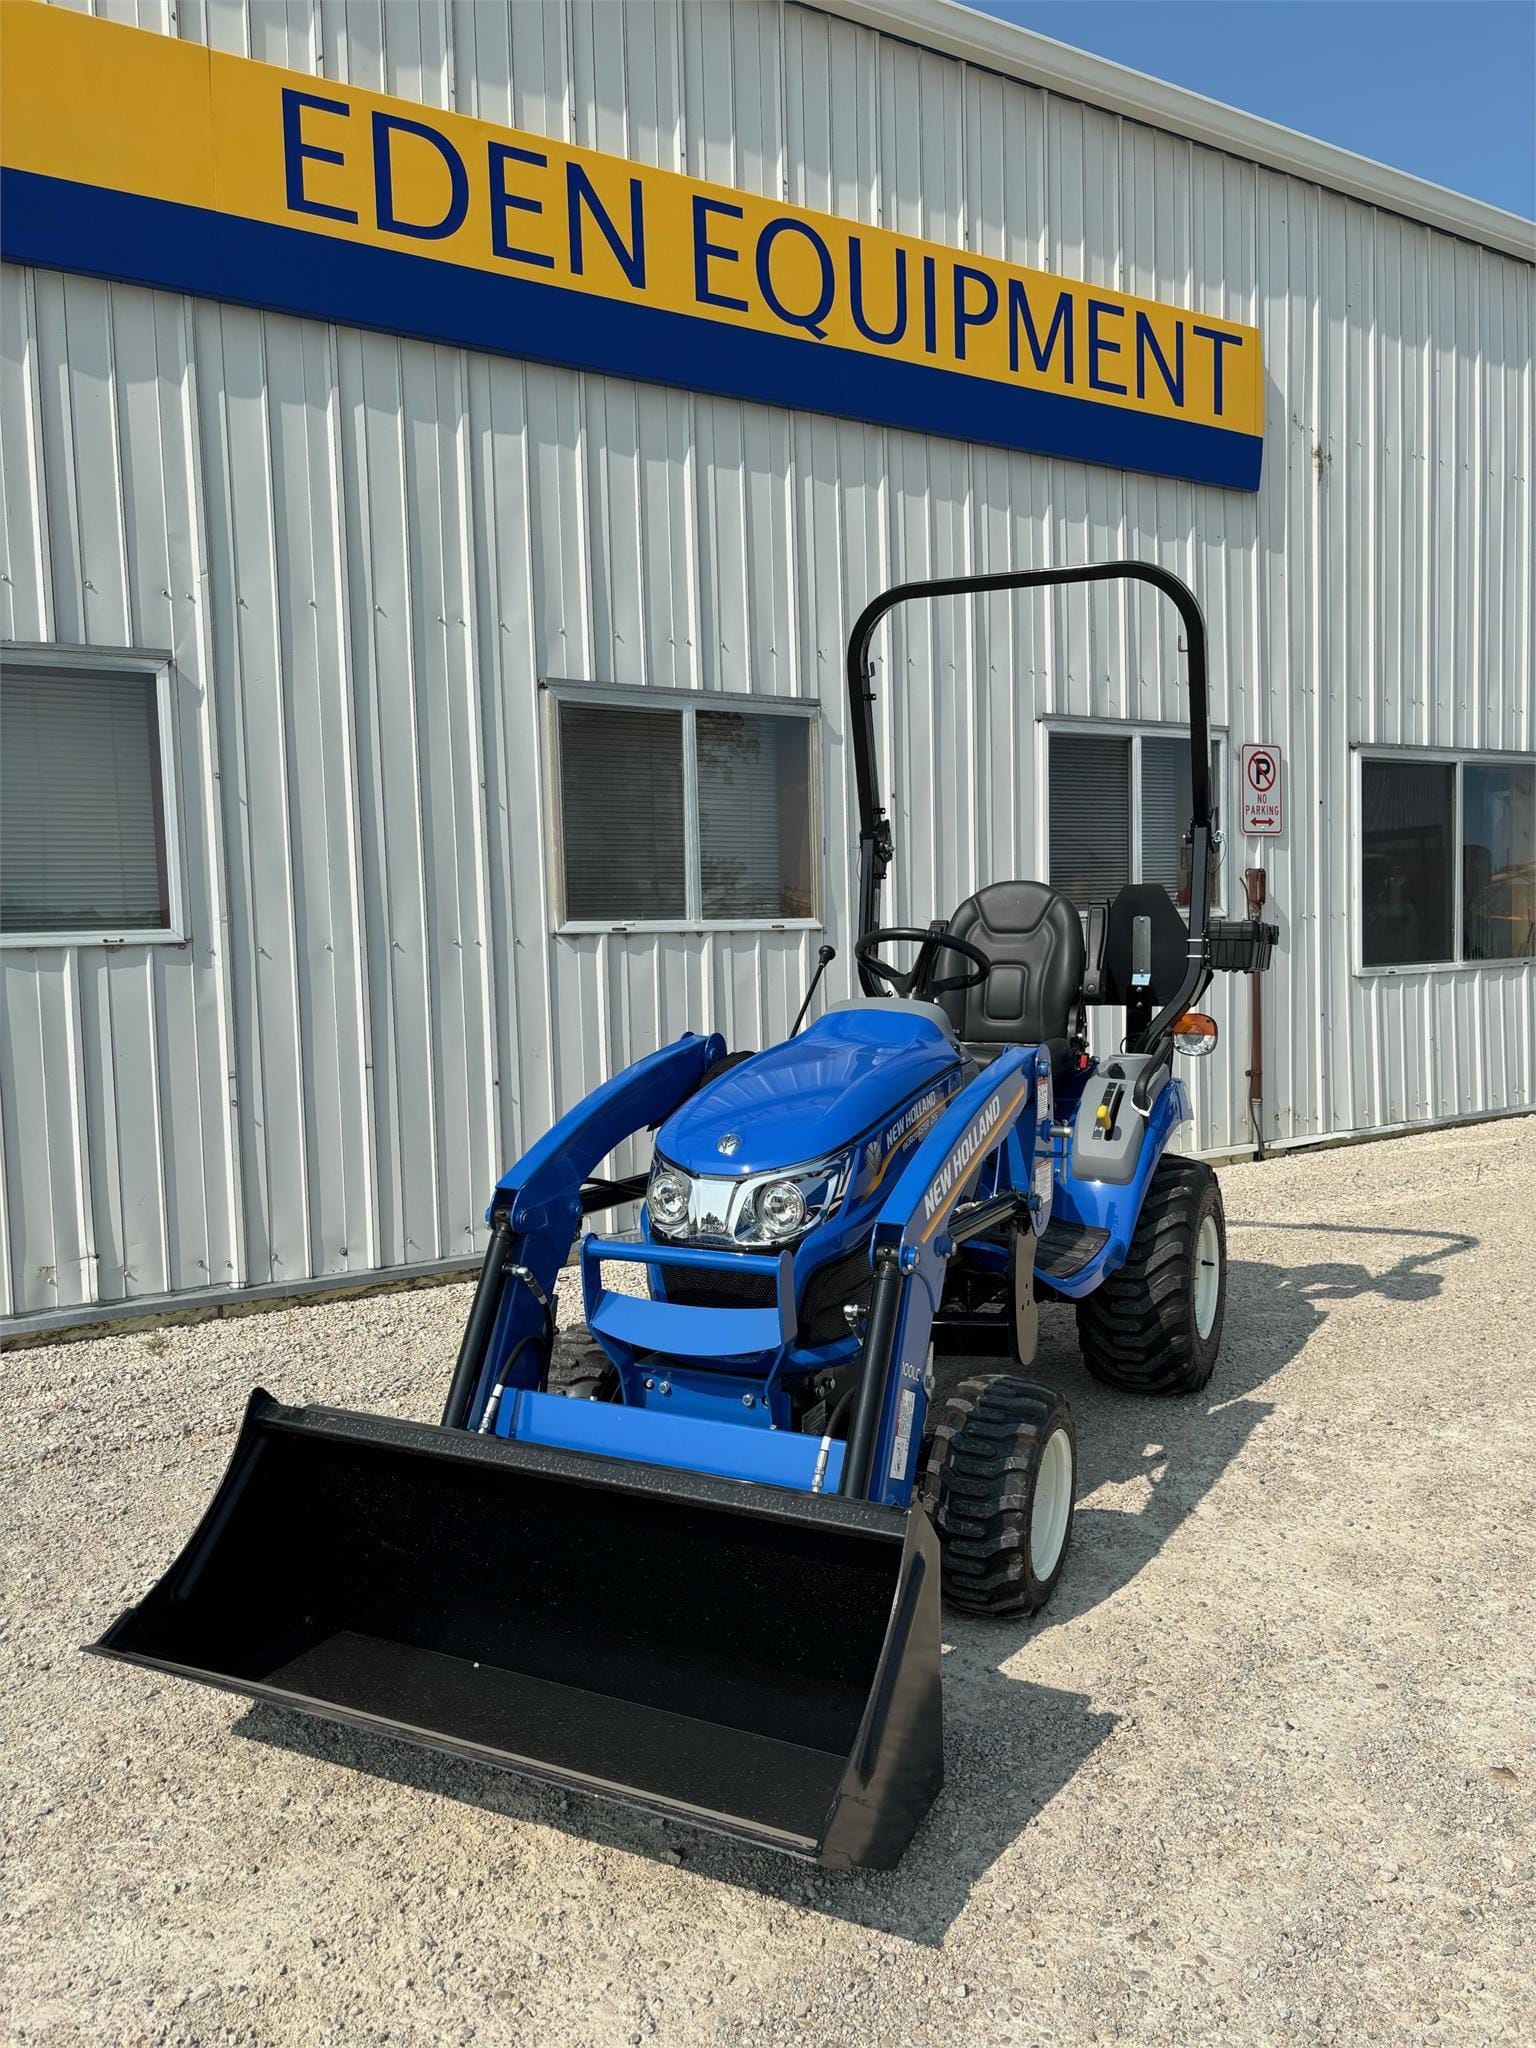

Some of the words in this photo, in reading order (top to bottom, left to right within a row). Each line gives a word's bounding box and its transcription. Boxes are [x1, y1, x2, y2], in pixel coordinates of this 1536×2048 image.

[281, 87, 646, 289] EDEN
[692, 195, 1243, 416] EQUIPMENT
[1245, 805, 1279, 816] PARKING
[1257, 794, 1267, 804] NO
[886, 1116, 904, 1150] NEW
[905, 1091, 936, 1128] HOLLAND
[924, 1162, 952, 1220] NEW
[953, 1095, 1000, 1178] HOLLAND
